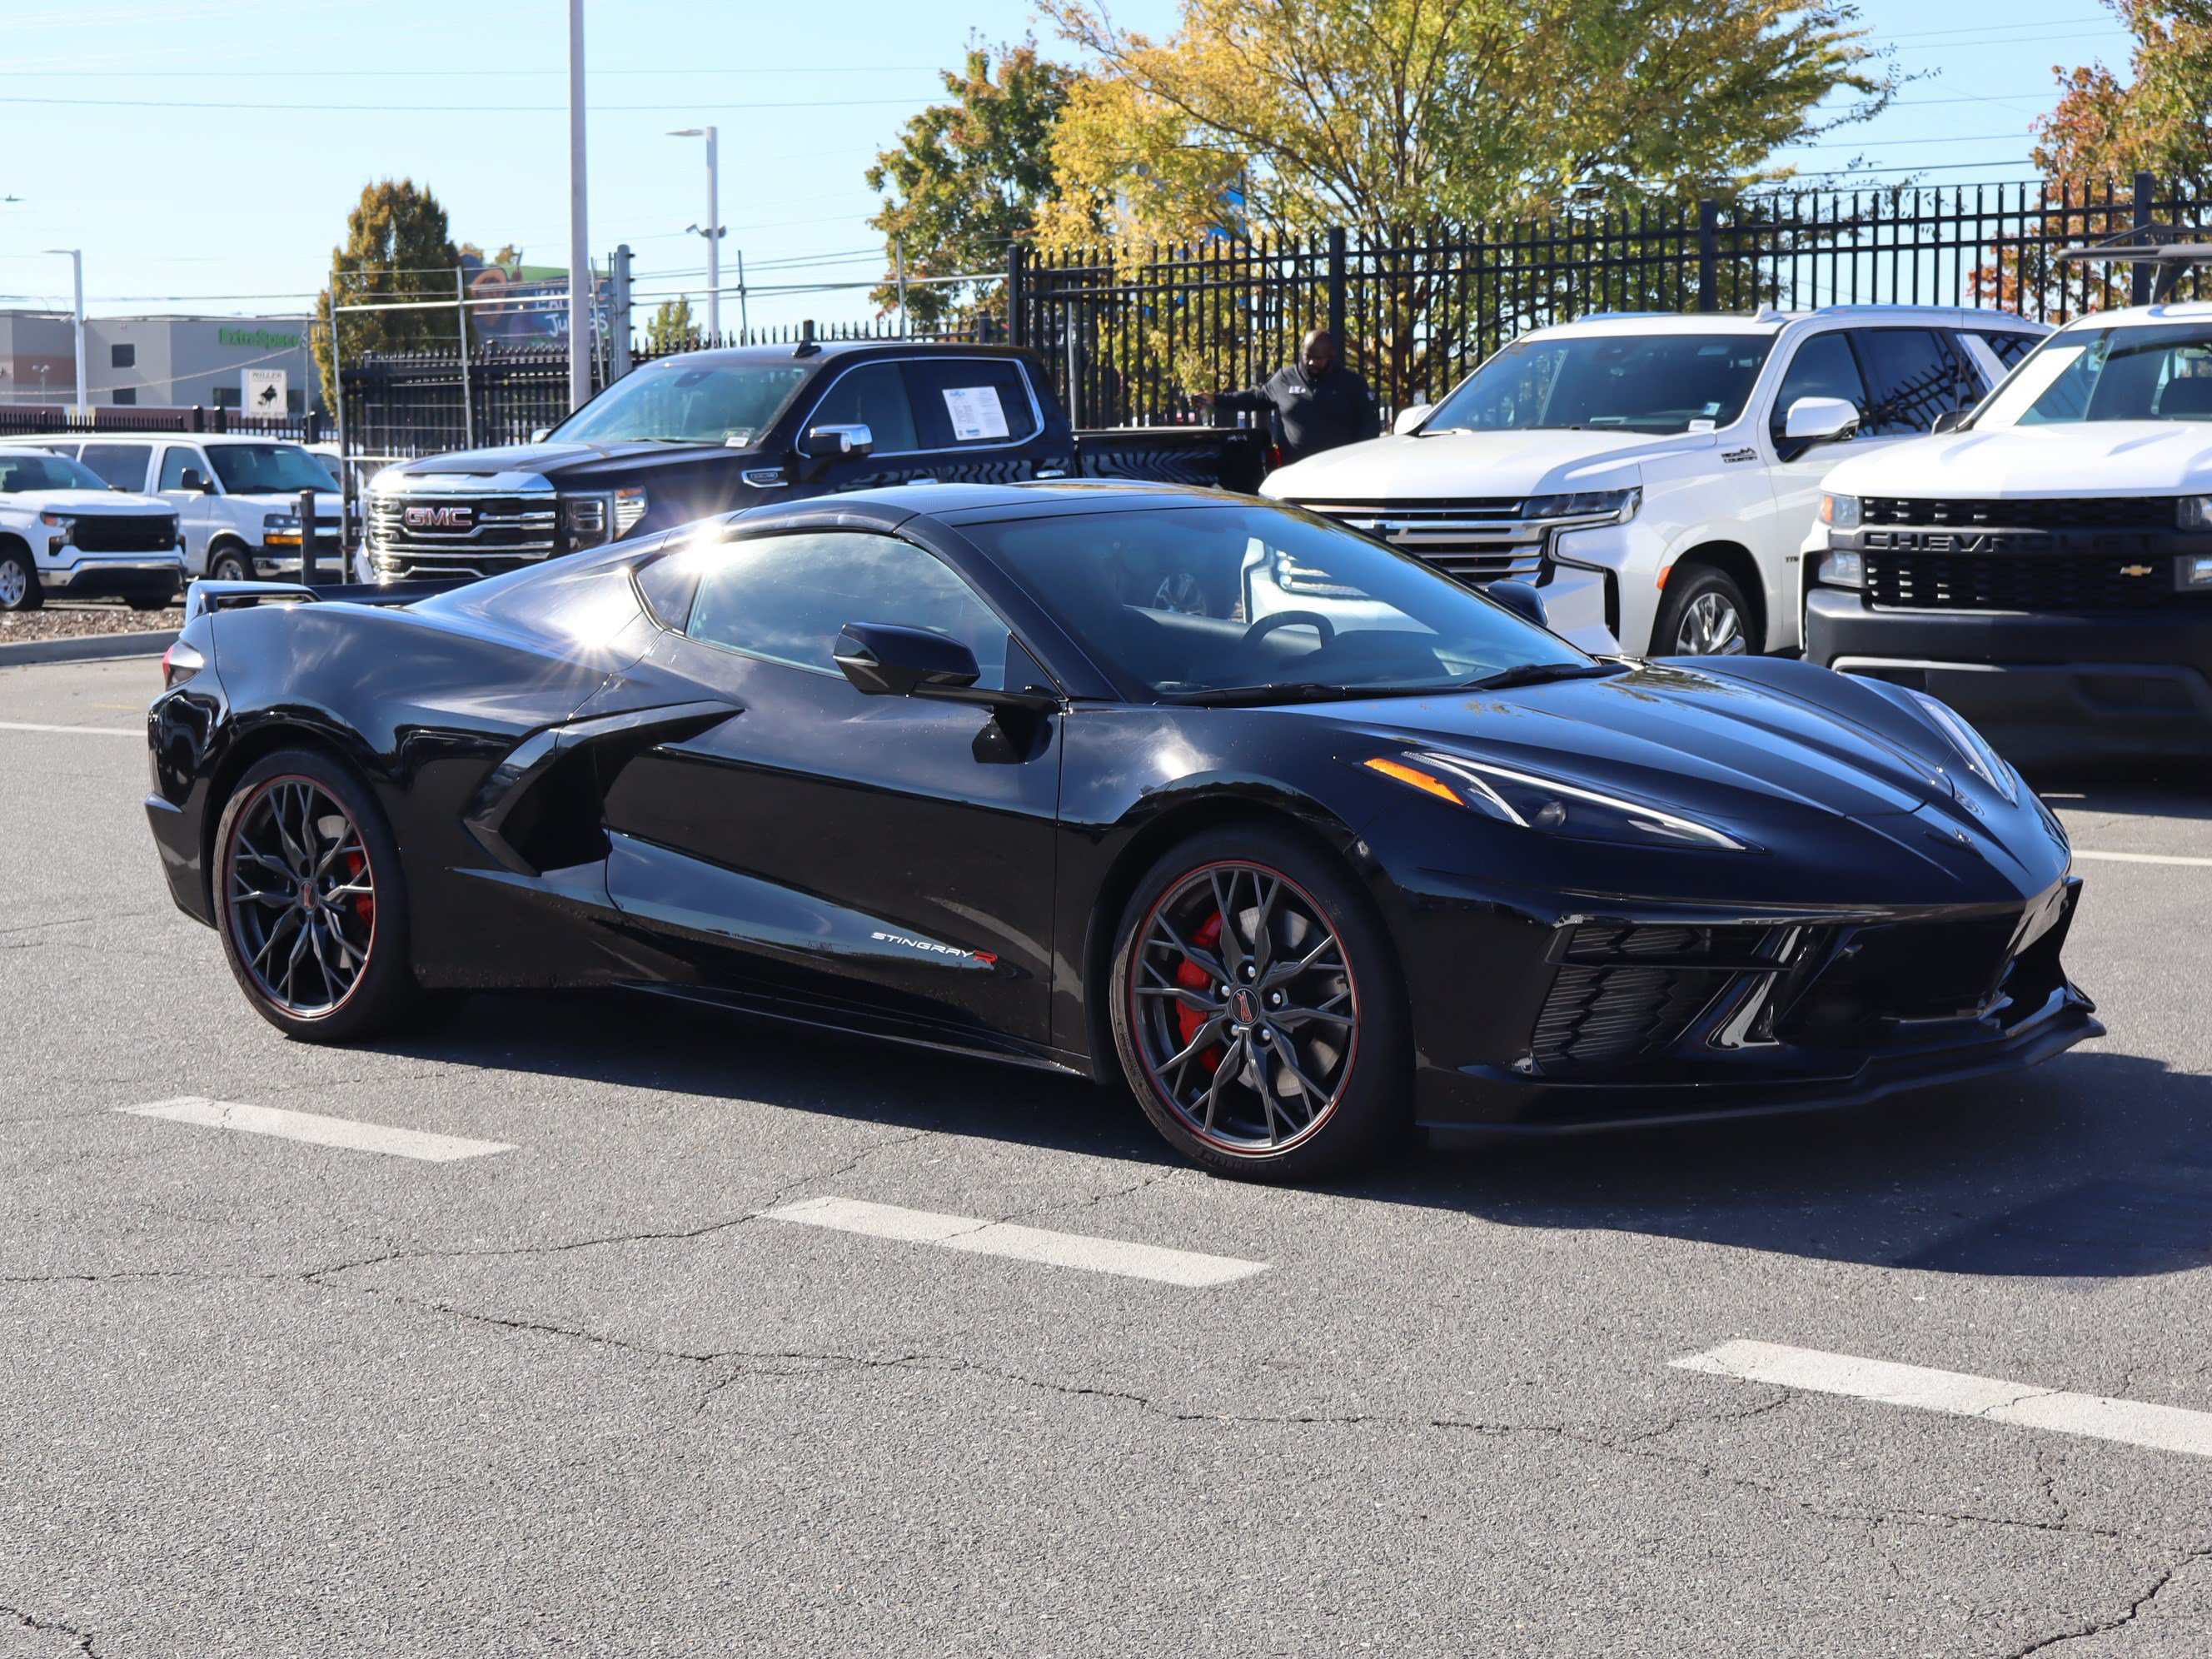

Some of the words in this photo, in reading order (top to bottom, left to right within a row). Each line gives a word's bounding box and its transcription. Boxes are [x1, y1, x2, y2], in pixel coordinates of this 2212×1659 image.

[406, 507, 472, 526] GMC
[1864, 532, 2160, 552] CHEVROLET
[870, 931, 974, 958] STINGRAY
